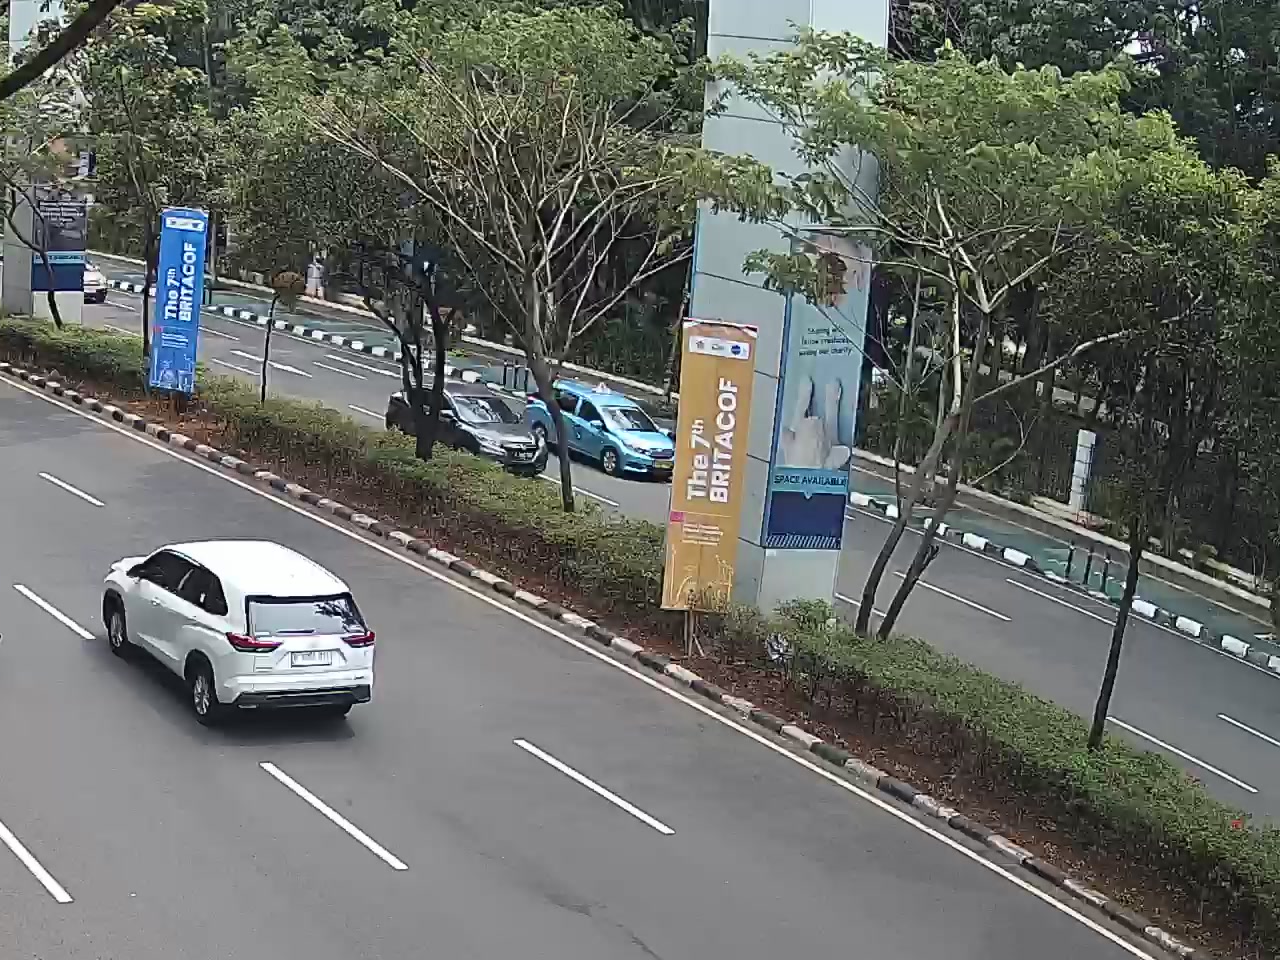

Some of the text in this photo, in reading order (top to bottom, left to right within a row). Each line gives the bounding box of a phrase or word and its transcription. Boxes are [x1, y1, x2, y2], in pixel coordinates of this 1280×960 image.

[178, 241, 197, 322] BRITACOF
[688, 419, 711, 451] 7th
[709, 377, 740, 503] BRITACOF
[687, 454, 709, 500] The
[774, 475, 847, 487] SPACE AVAILABLE
